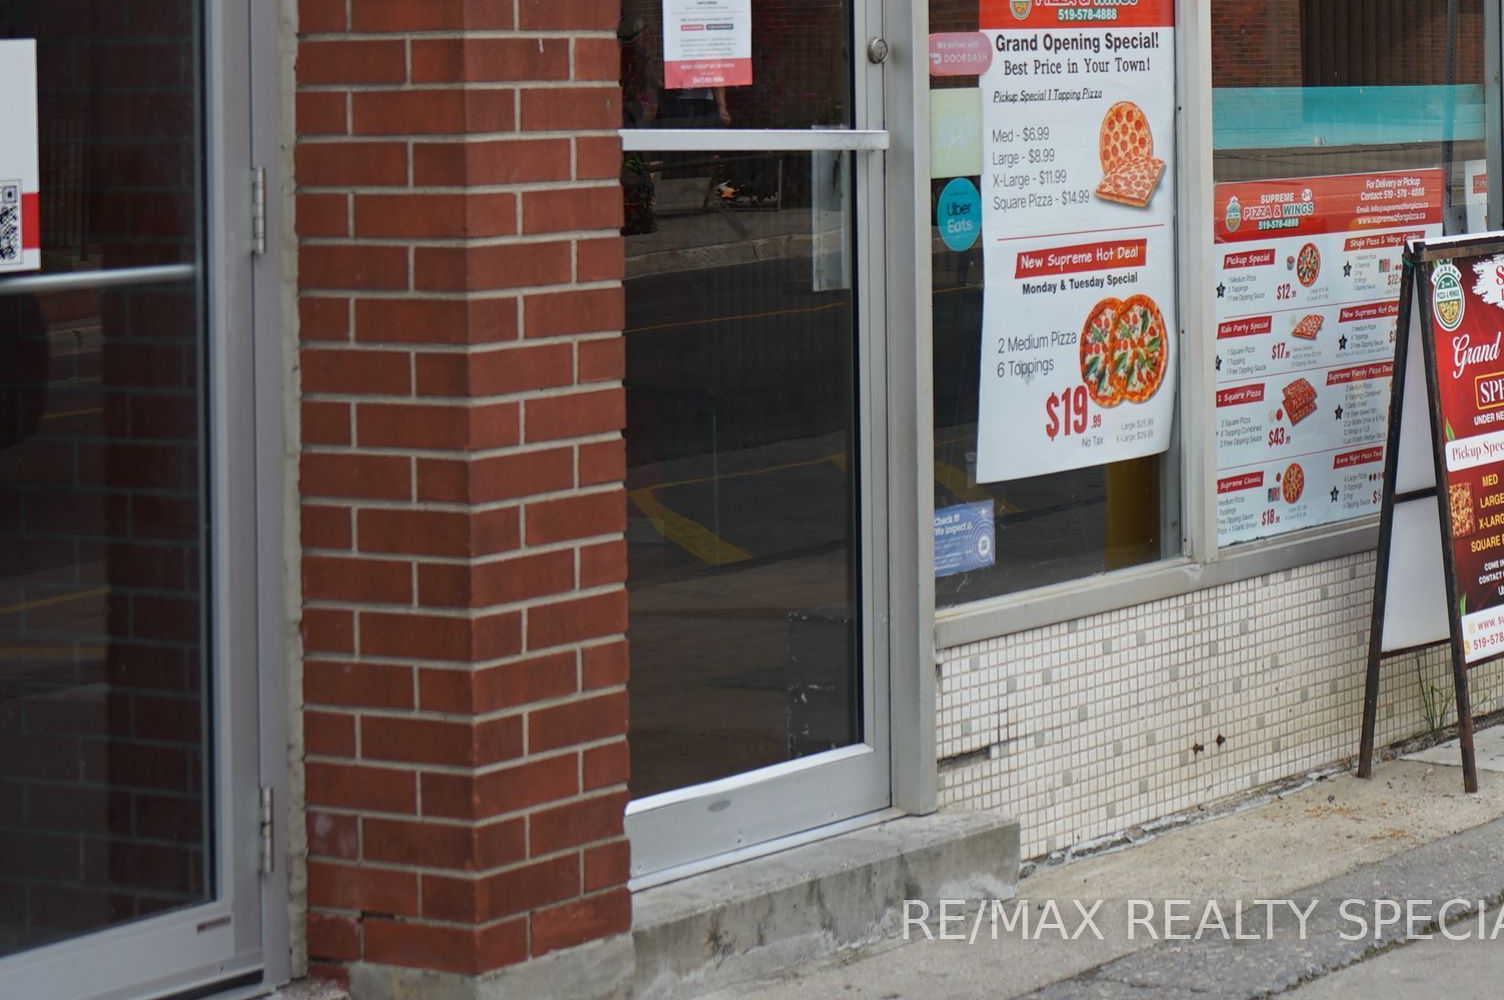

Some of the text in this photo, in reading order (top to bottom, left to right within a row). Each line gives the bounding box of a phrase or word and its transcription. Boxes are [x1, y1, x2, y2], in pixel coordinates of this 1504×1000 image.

[1058, 8, 1117, 21] 519-578-4888
[995, 32, 1159, 55] Grand Opening Special!
[1004, 57, 1151, 76] Best Price in Your Town!
[993, 90, 1019, 104] Pickup
[1020, 89, 1046, 104] Special
[1082, 87, 1102, 99] Pizza
[992, 126, 1050, 143] Med $6.99
[992, 148, 1055, 166] Large $8.99
[992, 169, 1067, 187] X-Large $11.99
[1375, 179, 1397, 189] Delivery
[1404, 177, 1420, 187] Pickup
[993, 191, 1090, 212] Square Pizza $14.99
[1260, 192, 1295, 204] SUPREME
[947, 201, 972, 216] Uber
[1243, 202, 1314, 221] PIZZA & WINGS
[947, 217, 972, 233] Eats
[1258, 218, 1299, 231] 519-578-4888
[1020, 245, 1139, 272] New Supreme Hot Deal
[1226, 253, 1270, 266] Pickup Special
[1022, 271, 1138, 296] Monday & Tuesday Special
[1233, 323, 1249, 335] Party
[1250, 321, 1269, 332] Special
[997, 330, 1077, 355] 2 Medium Pizza
[1271, 342, 1286, 361] $17
[1452, 332, 1502, 379] Grand
[997, 358, 1054, 378] 6 Toppings
[1045, 385, 1089, 442] $19
[1473, 414, 1495, 426] UNDER
[1081, 435, 1104, 448] No Tax
[1268, 427, 1285, 448] $43
[1451, 442, 1482, 462] Pickup
[1482, 474, 1499, 488] MED
[1479, 492, 1504, 509] LARGE
[1471, 535, 1501, 553] SQUARE
[1484, 562, 1499, 572] COME
[1478, 572, 1503, 585] CONTACT
[1478, 618, 1496, 631] WWW.
